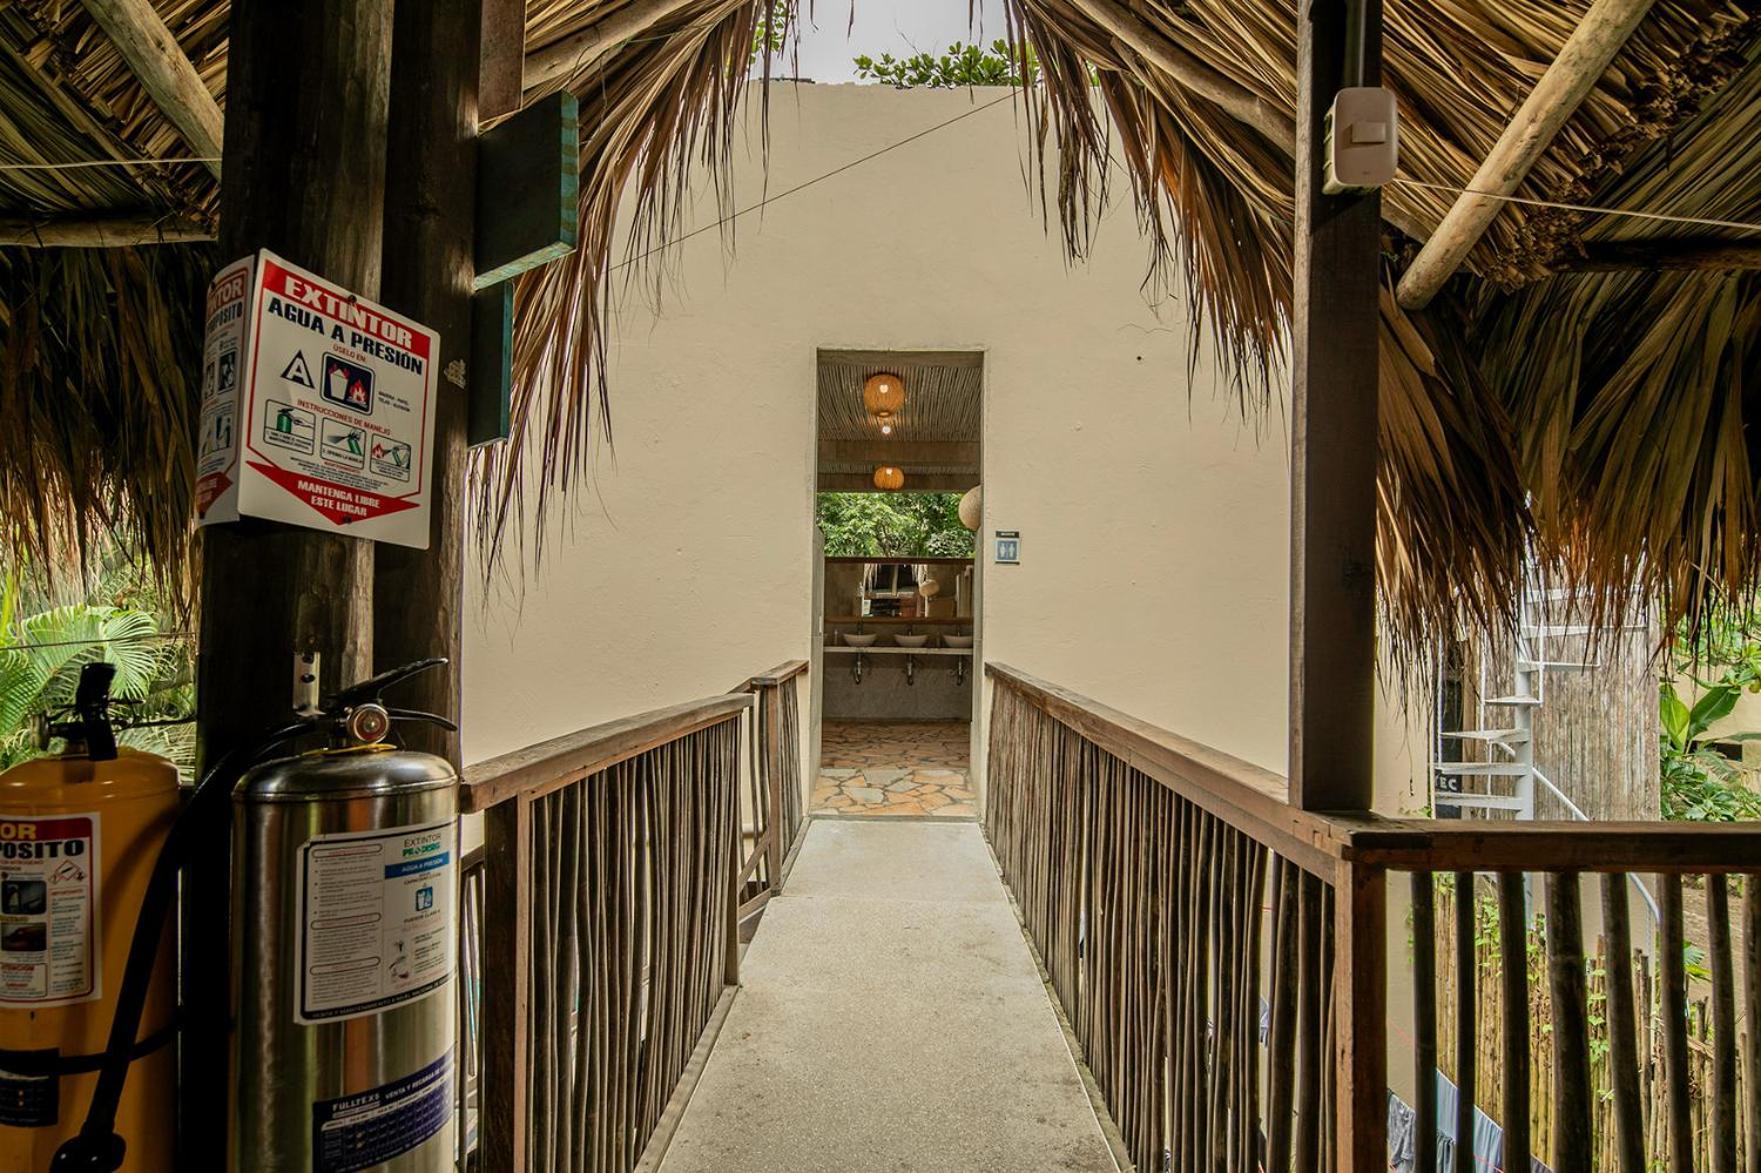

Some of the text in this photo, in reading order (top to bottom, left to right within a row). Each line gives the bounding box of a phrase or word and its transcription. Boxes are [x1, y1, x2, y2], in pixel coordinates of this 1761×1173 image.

[285, 276, 412, 349] EXTINTOR
[268, 297, 423, 375] AGUA A PRESIÓN
[286, 359, 310, 387] A
[297, 400, 391, 436] INSTRUCCIONES DE MANEJO
[298, 481, 380, 508] MANTENGA LIBRE
[311, 495, 367, 517] ESTE LUGAR
[404, 832, 441, 848] EXTINTOR
